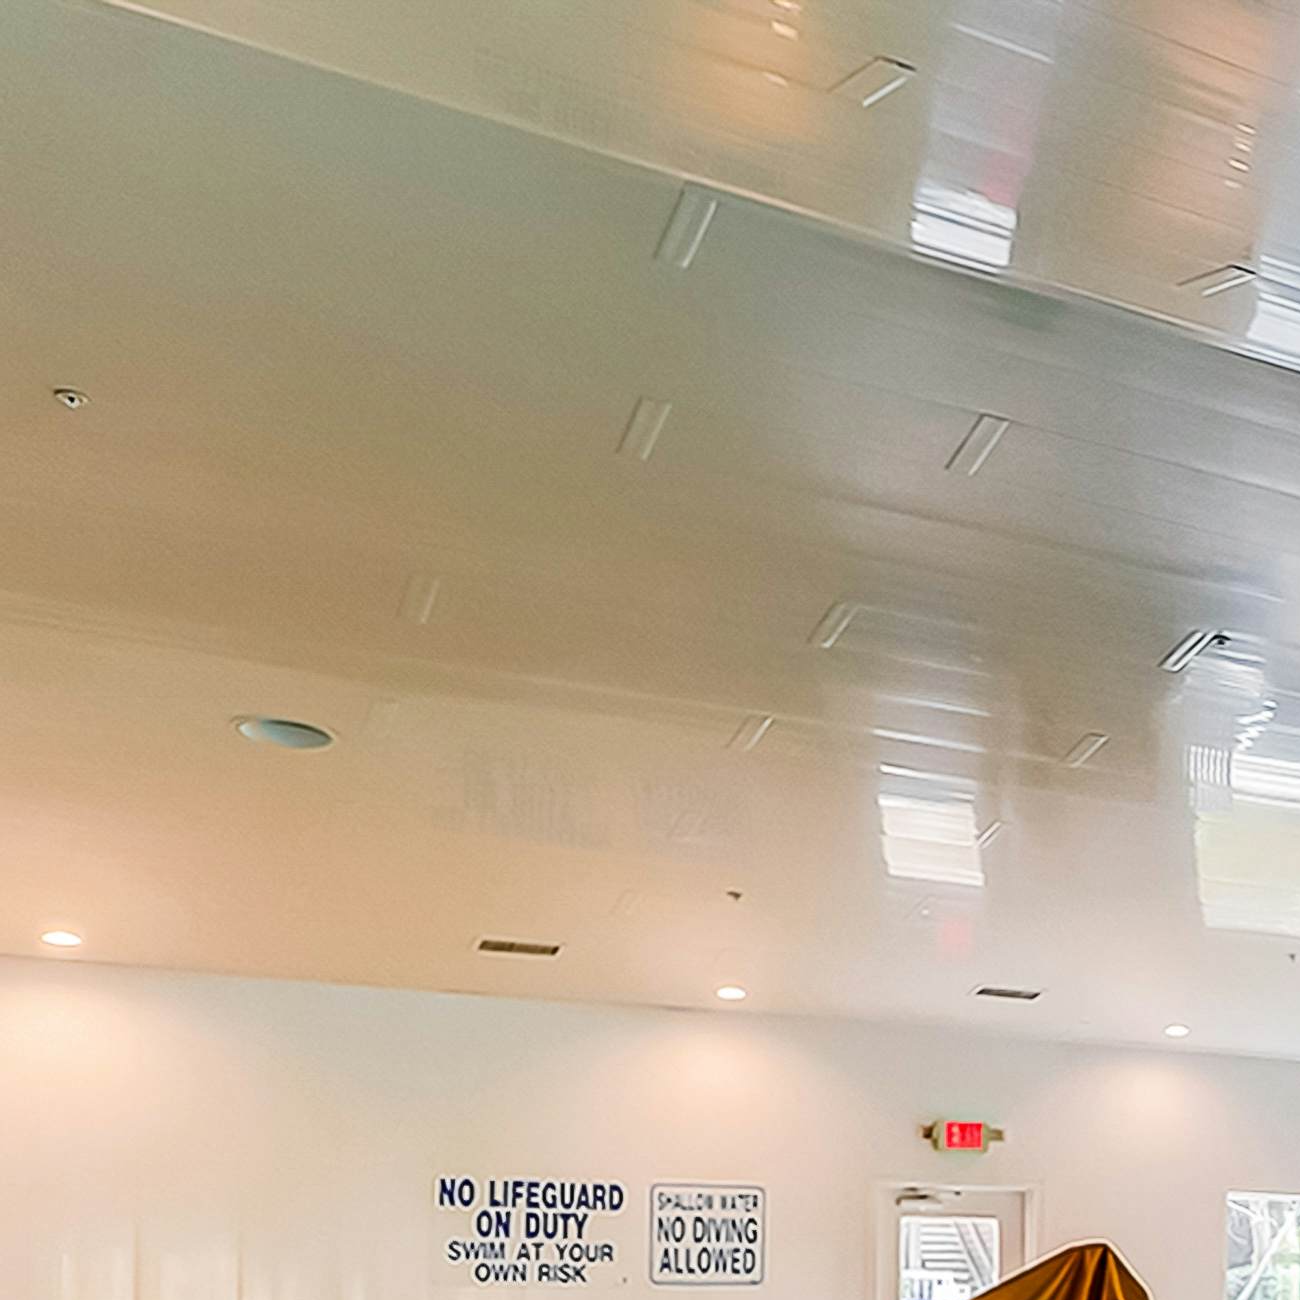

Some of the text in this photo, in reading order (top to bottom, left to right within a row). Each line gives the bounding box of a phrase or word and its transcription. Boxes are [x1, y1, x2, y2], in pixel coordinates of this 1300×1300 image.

[439, 1178, 624, 1211] NO LIFEGUARD
[476, 1210, 588, 1239] ON DUTY
[657, 1216, 758, 1244] NO DIVING
[448, 1240, 614, 1262] SWIM AT YOUR
[659, 1247, 756, 1274] ALLOWED
[475, 1263, 587, 1283] OWN RISK
